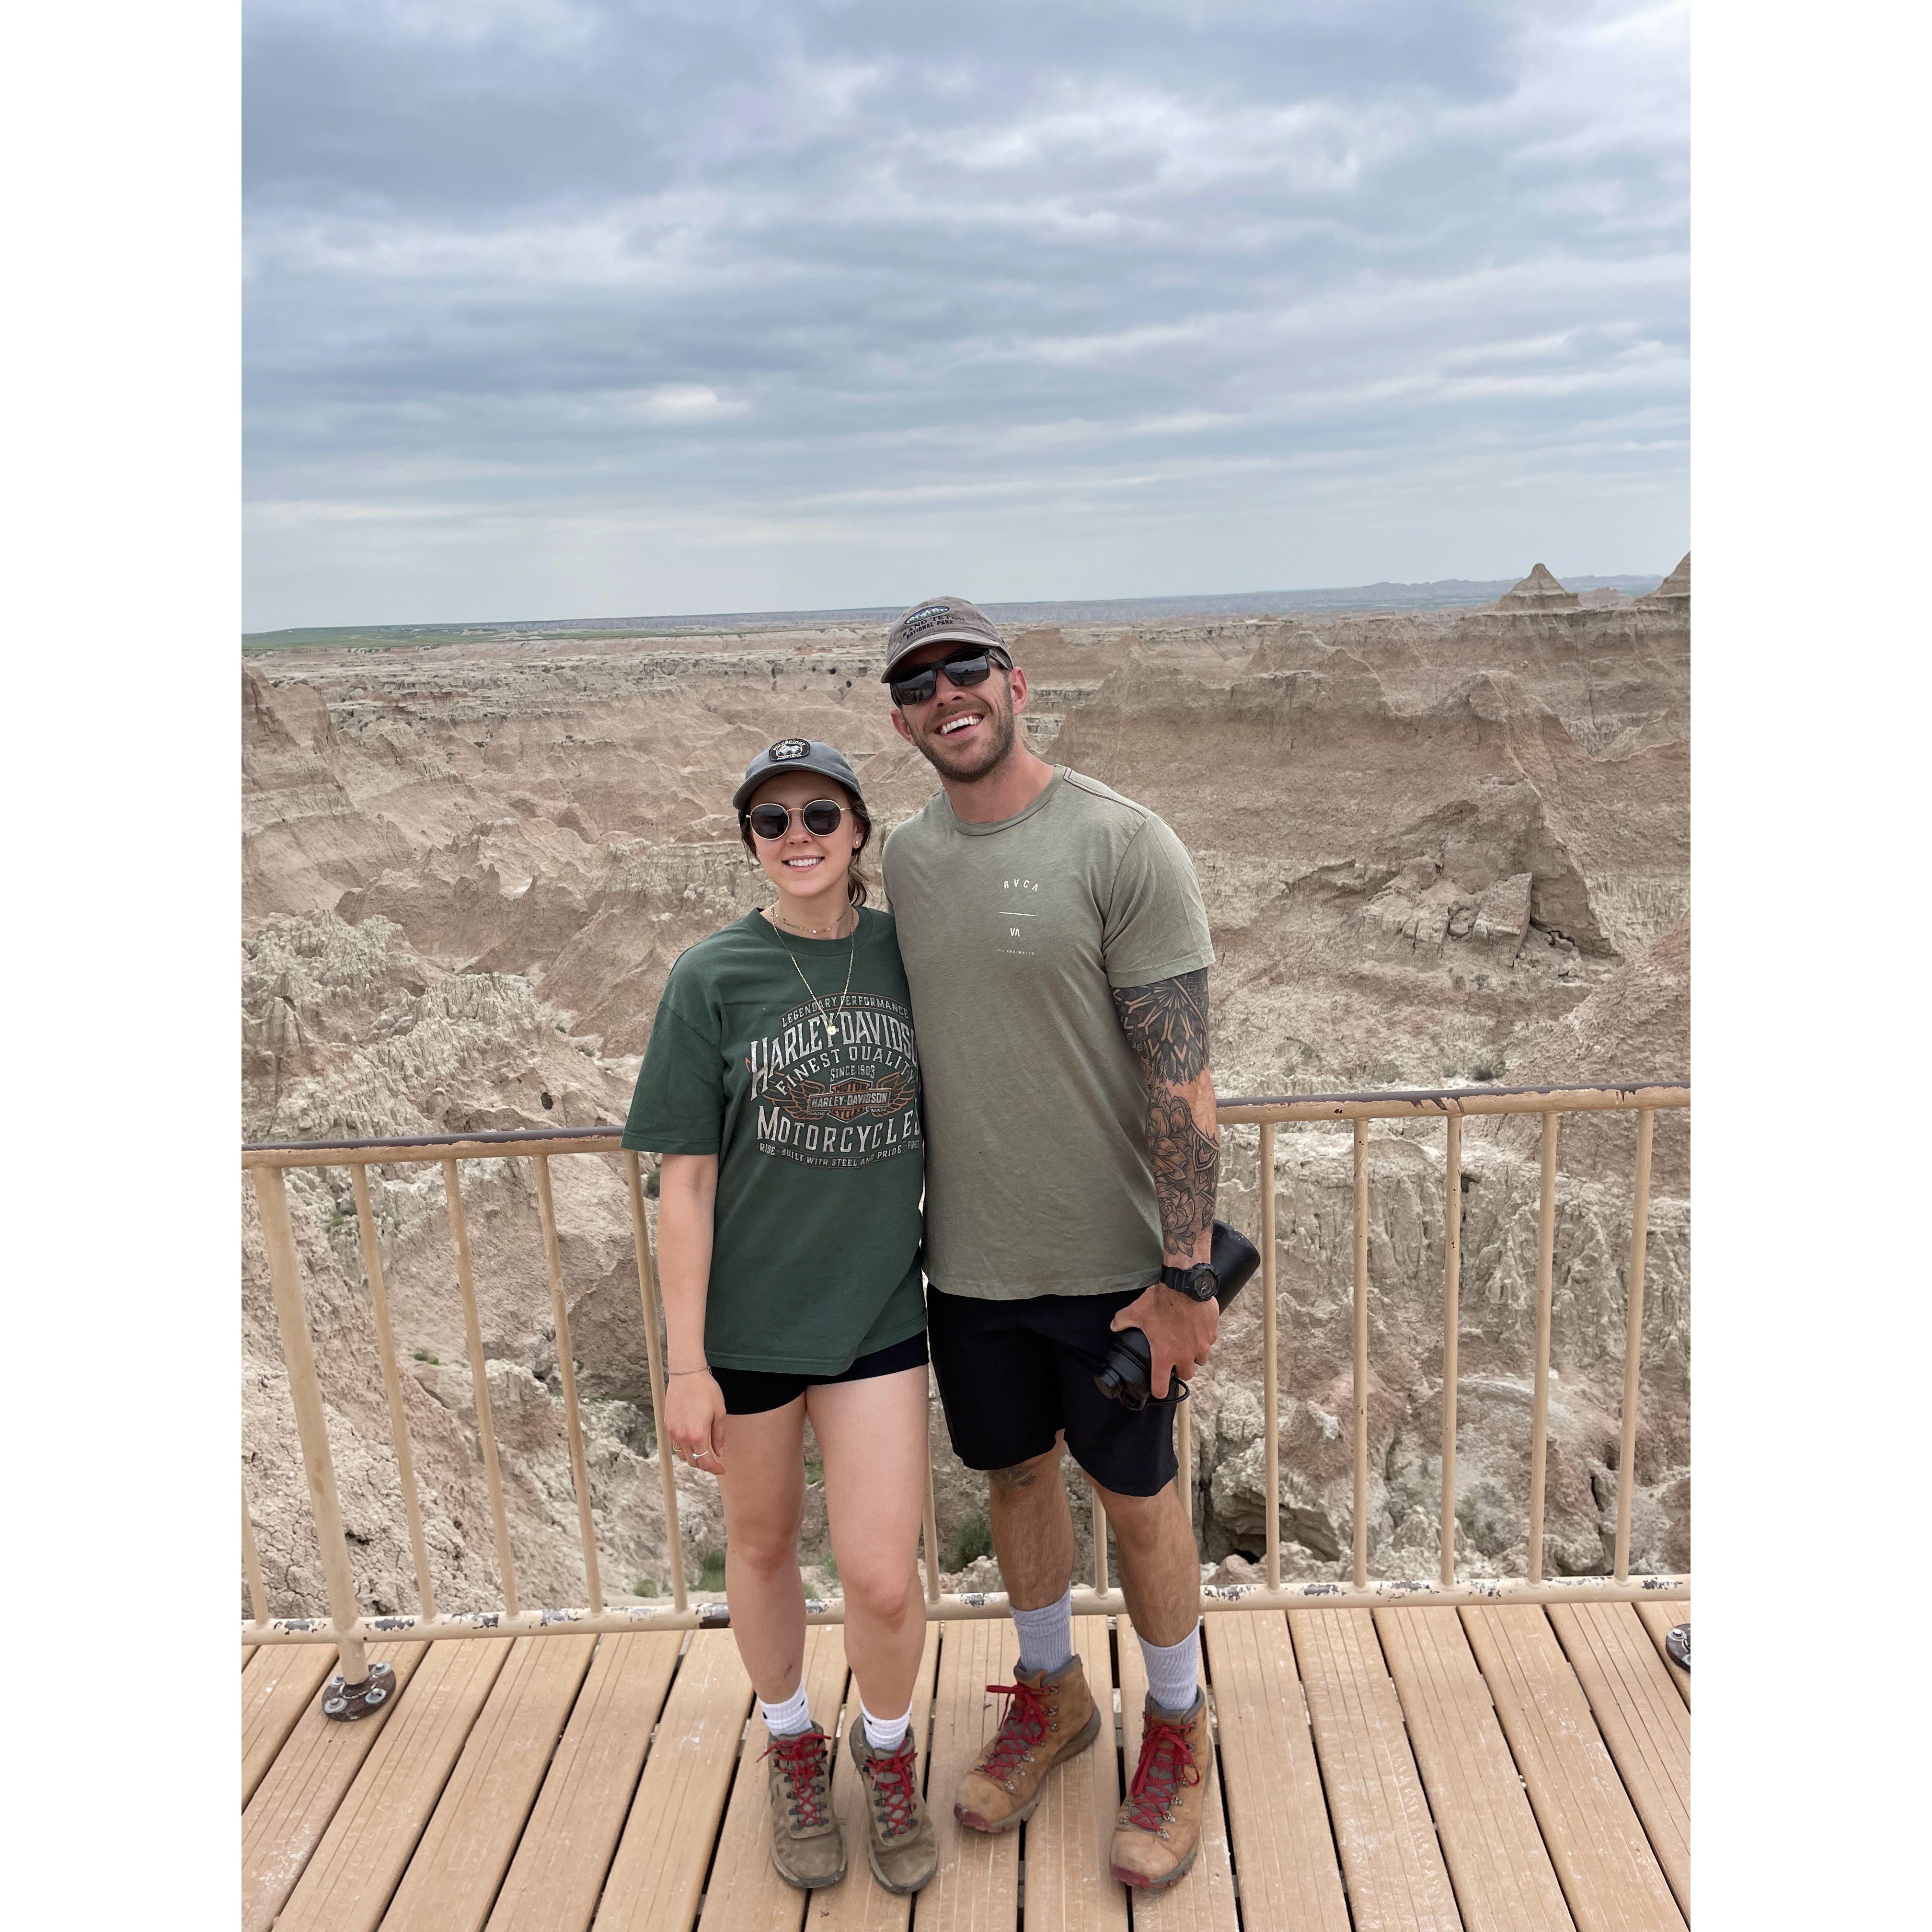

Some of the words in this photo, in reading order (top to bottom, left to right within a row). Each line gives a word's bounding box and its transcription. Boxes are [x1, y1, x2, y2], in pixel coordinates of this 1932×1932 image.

[899, 620, 927, 643] RAND
[907, 622, 934, 640] NATIONAL
[1003, 879, 1038, 892] RVCA
[1010, 928, 1020, 937] VA
[782, 997, 837, 1028] LEGENDARY
[774, 1048, 840, 1096] FINEST
[849, 1046, 915, 1084] QUALITY
[830, 1065, 855, 1082] SINCE
[857, 1065, 875, 1079] 1903
[811, 1092, 888, 1108] HARLEY-DAVIDSON
[759, 1143, 776, 1156] RIDE
[781, 1148, 805, 1162] BUILT
[806, 1156, 828, 1166] WITH
[860, 1154, 875, 1166] AND
[877, 1145, 902, 1160] PRIDE
